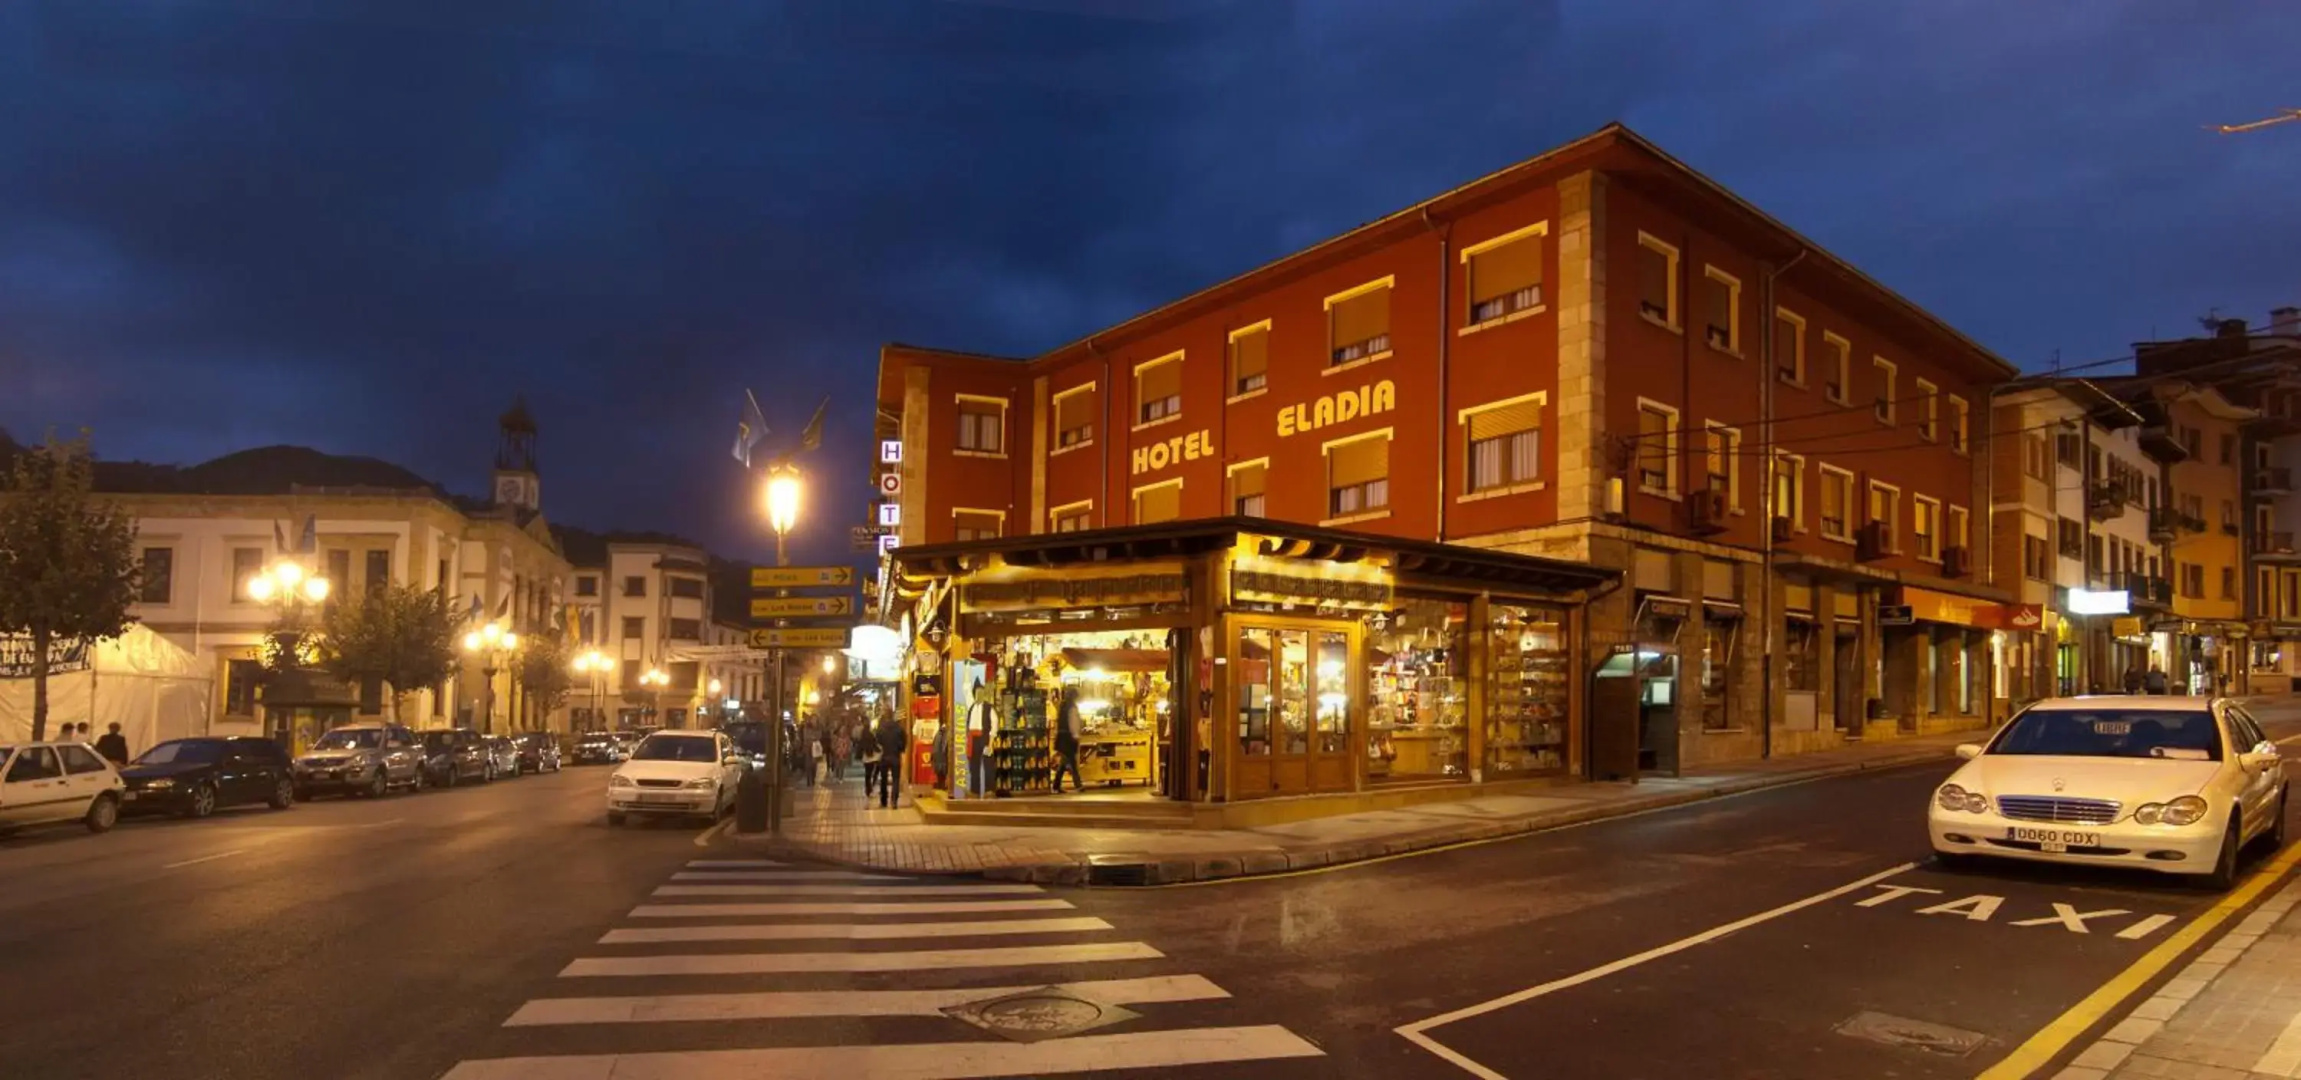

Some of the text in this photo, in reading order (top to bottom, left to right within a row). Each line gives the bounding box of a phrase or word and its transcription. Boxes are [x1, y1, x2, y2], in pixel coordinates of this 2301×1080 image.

[1132, 379, 1395, 475] HOTEL ELADIA
[884, 443, 900, 549] HOTE
[955, 704, 967, 787] ASTURIAS
[2018, 827, 2095, 846] 0060 CDX
[1853, 884, 2178, 940] TAXI
